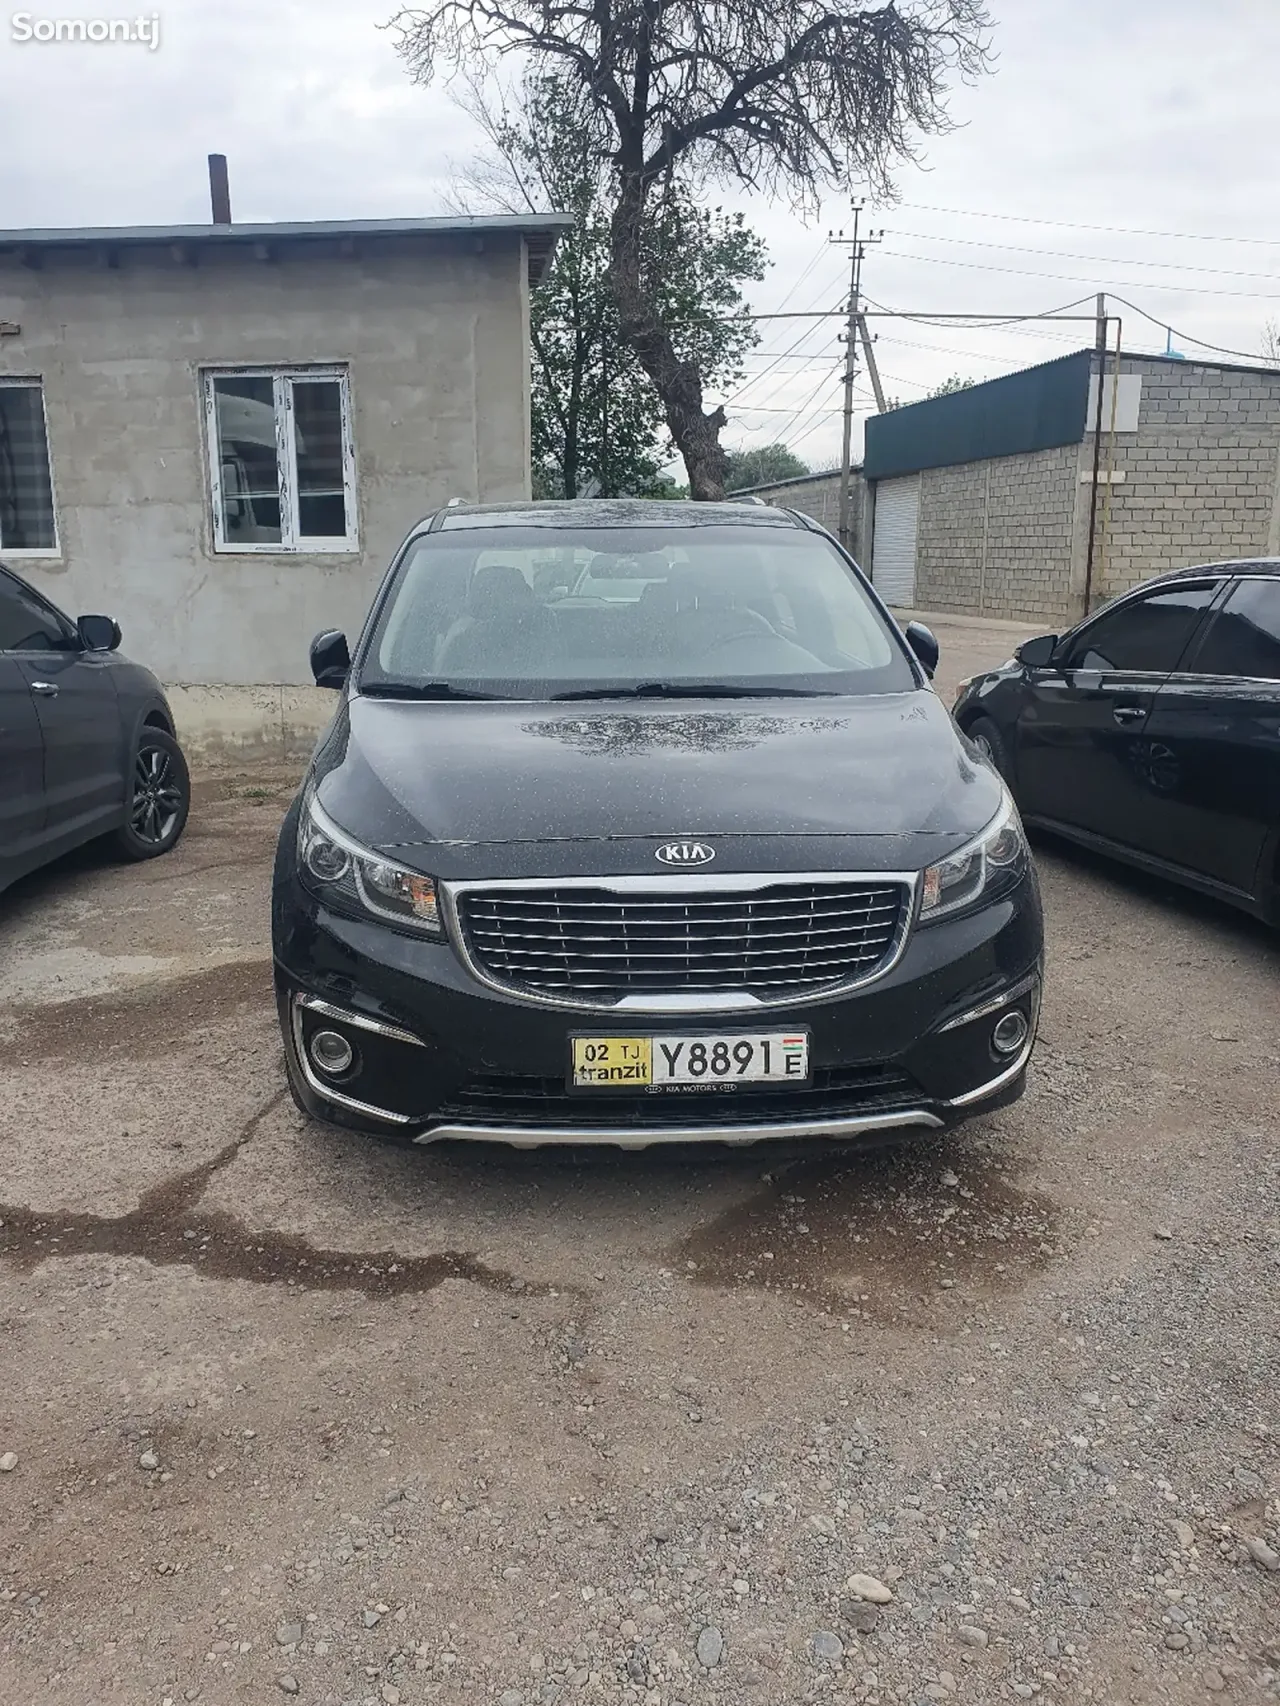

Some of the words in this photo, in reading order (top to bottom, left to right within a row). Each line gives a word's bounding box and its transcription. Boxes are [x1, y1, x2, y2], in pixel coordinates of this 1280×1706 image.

[665, 844, 707, 861] KIA
[584, 1044, 610, 1061] 02
[620, 1045, 640, 1060] TJ
[658, 1040, 771, 1077] Y8891
[578, 1062, 648, 1081] tranzit
[785, 1054, 801, 1075] E
[682, 1084, 717, 1092] MOTORS
